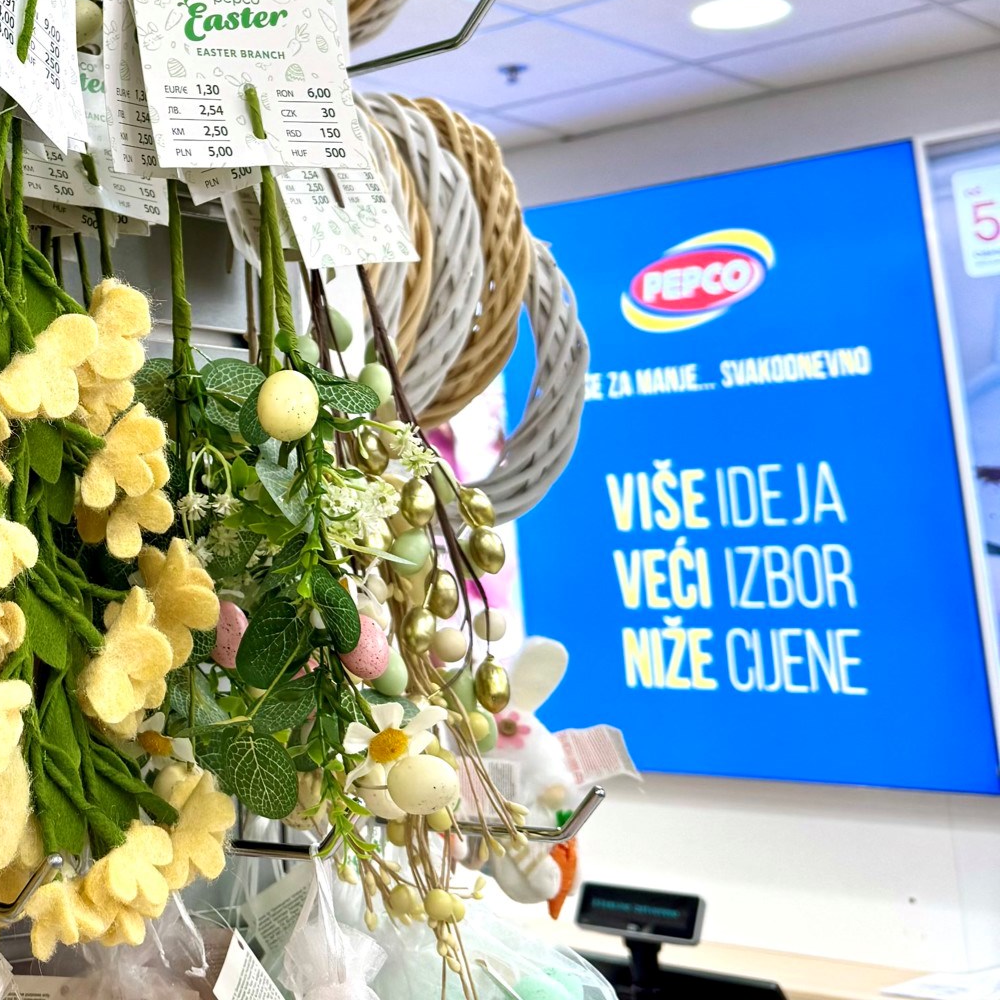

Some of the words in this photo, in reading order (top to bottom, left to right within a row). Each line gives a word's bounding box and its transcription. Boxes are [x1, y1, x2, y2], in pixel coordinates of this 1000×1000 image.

[44, 18, 61, 43] 9,00
[50, 42, 60, 59] 50
[197, 47, 237, 58] EASTER
[240, 50, 285, 60] BRANCH
[45, 53, 60, 75] 250
[45, 69, 60, 90] 750
[164, 85, 188, 95] EUR/€
[196, 84, 220, 97] 1,30
[276, 89, 294, 98] RON
[307, 87, 331, 100] 6,00
[200, 105, 224, 117] 2,54
[281, 109, 297, 118] CZK
[322, 108, 335, 119] 30
[172, 127, 185, 136] KM
[203, 125, 228, 138] 2,50
[286, 129, 302, 138] RSD
[320, 128, 341, 138] 150
[138, 133, 153, 145] 2,50
[175, 148, 192, 157] PLN
[208, 146, 233, 159] 5,00
[292, 149, 307, 158] HUF
[325, 148, 346, 158] 500
[123, 153, 133, 163] PLN
[141, 155, 157, 167] 5,00
[48, 168, 69, 179] 2,50
[205, 178, 220, 188] PLN
[231, 167, 252, 180] 5,00
[28, 181, 42, 190] PLN
[53, 185, 74, 196] 5,00
[140, 187, 156, 198] 150
[308, 183, 324, 192] 2,50
[312, 195, 329, 204] 5,00
[144, 204, 161, 216] 500
[642, 256, 753, 303] PEPCO
[607, 369, 632, 399] ZA
[720, 345, 871, 388] SVAKODNEVNO
[606, 458, 710, 533] VIŠE
[716, 461, 847, 527] IDEJA
[613, 536, 712, 611] VEĆI
[724, 545, 858, 610] IZBOR
[621, 616, 718, 690] NIŽE
[725, 628, 868, 696] CIJENE
